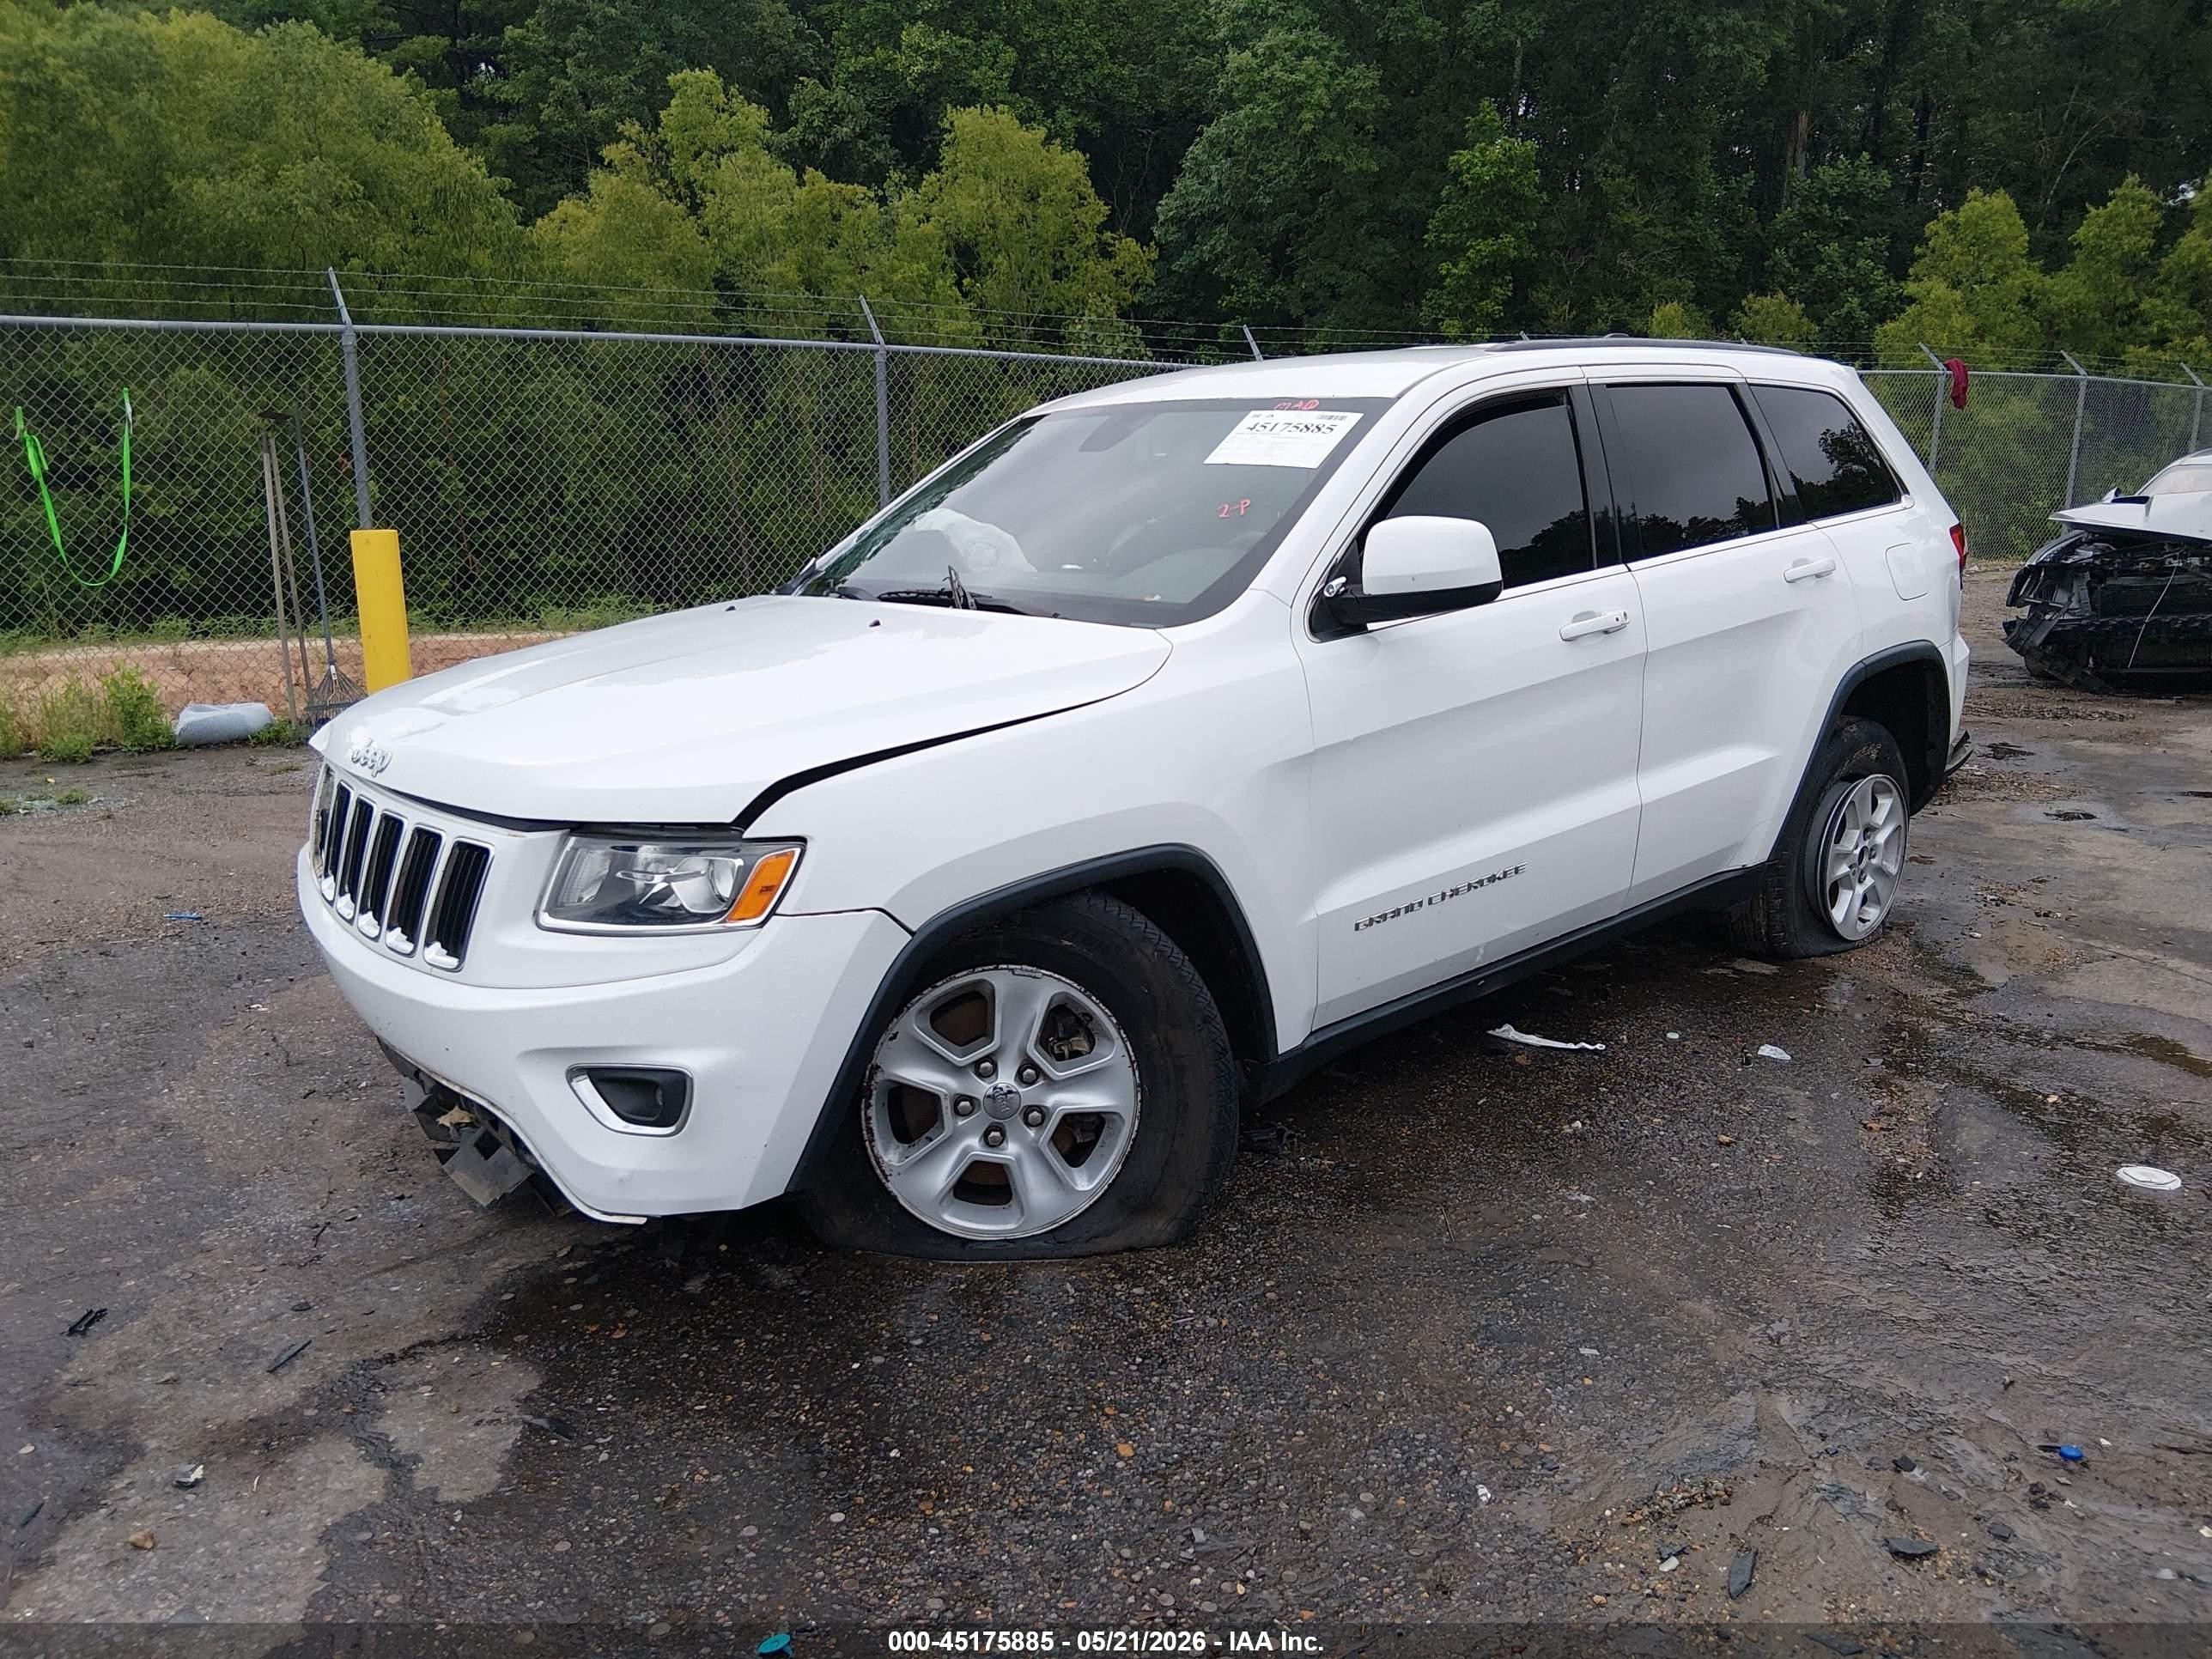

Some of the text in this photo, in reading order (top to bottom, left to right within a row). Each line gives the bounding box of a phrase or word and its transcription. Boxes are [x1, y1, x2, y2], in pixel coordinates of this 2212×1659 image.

[1246, 421, 1339, 434] 45175885
[351, 738, 392, 777] Jeep
[1354, 861, 1528, 932] GRAND CHEROKEE
